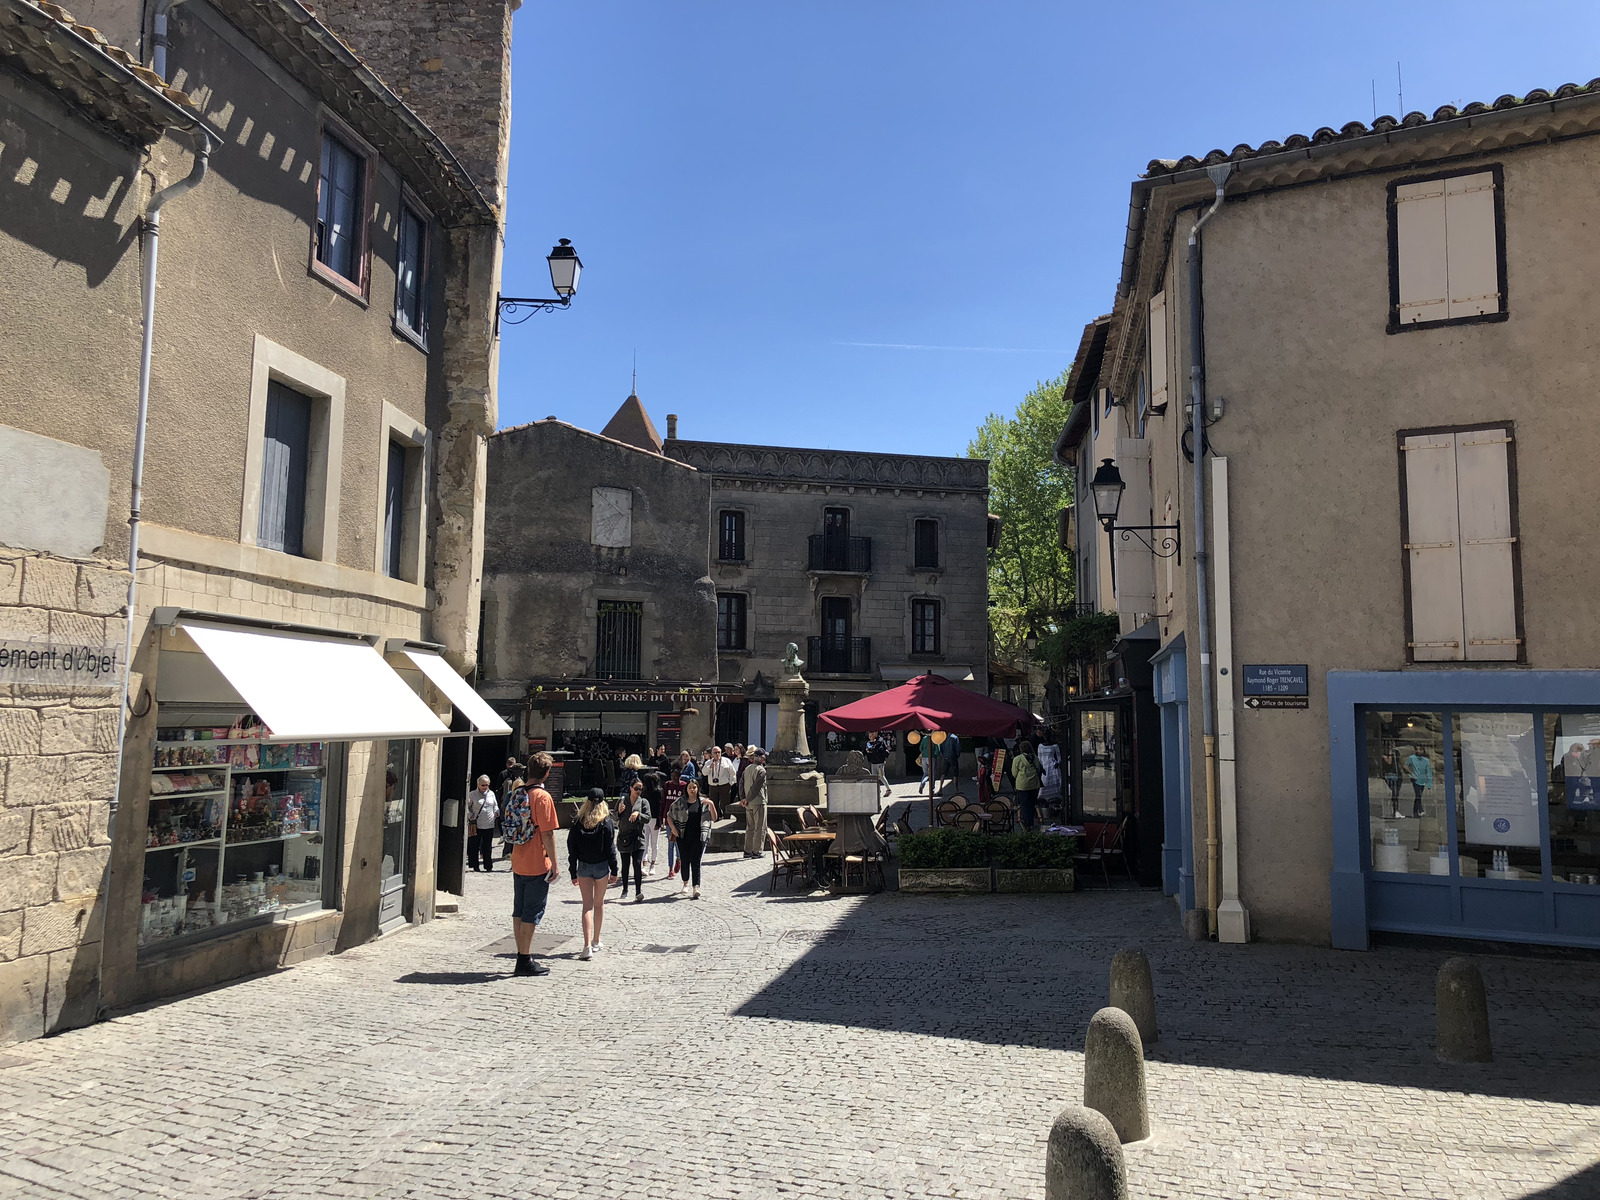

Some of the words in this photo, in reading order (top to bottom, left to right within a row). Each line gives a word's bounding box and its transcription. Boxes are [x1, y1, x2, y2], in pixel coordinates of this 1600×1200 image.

[63, 646, 117, 678] d'Objet
[1247, 677, 1266, 685] Raymond
[1267, 677, 1279, 685] Roger
[566, 692, 584, 700] LA
[587, 692, 647, 701] TAVERNE
[651, 694, 667, 702] DU
[671, 694, 728, 702] CHATEAU
